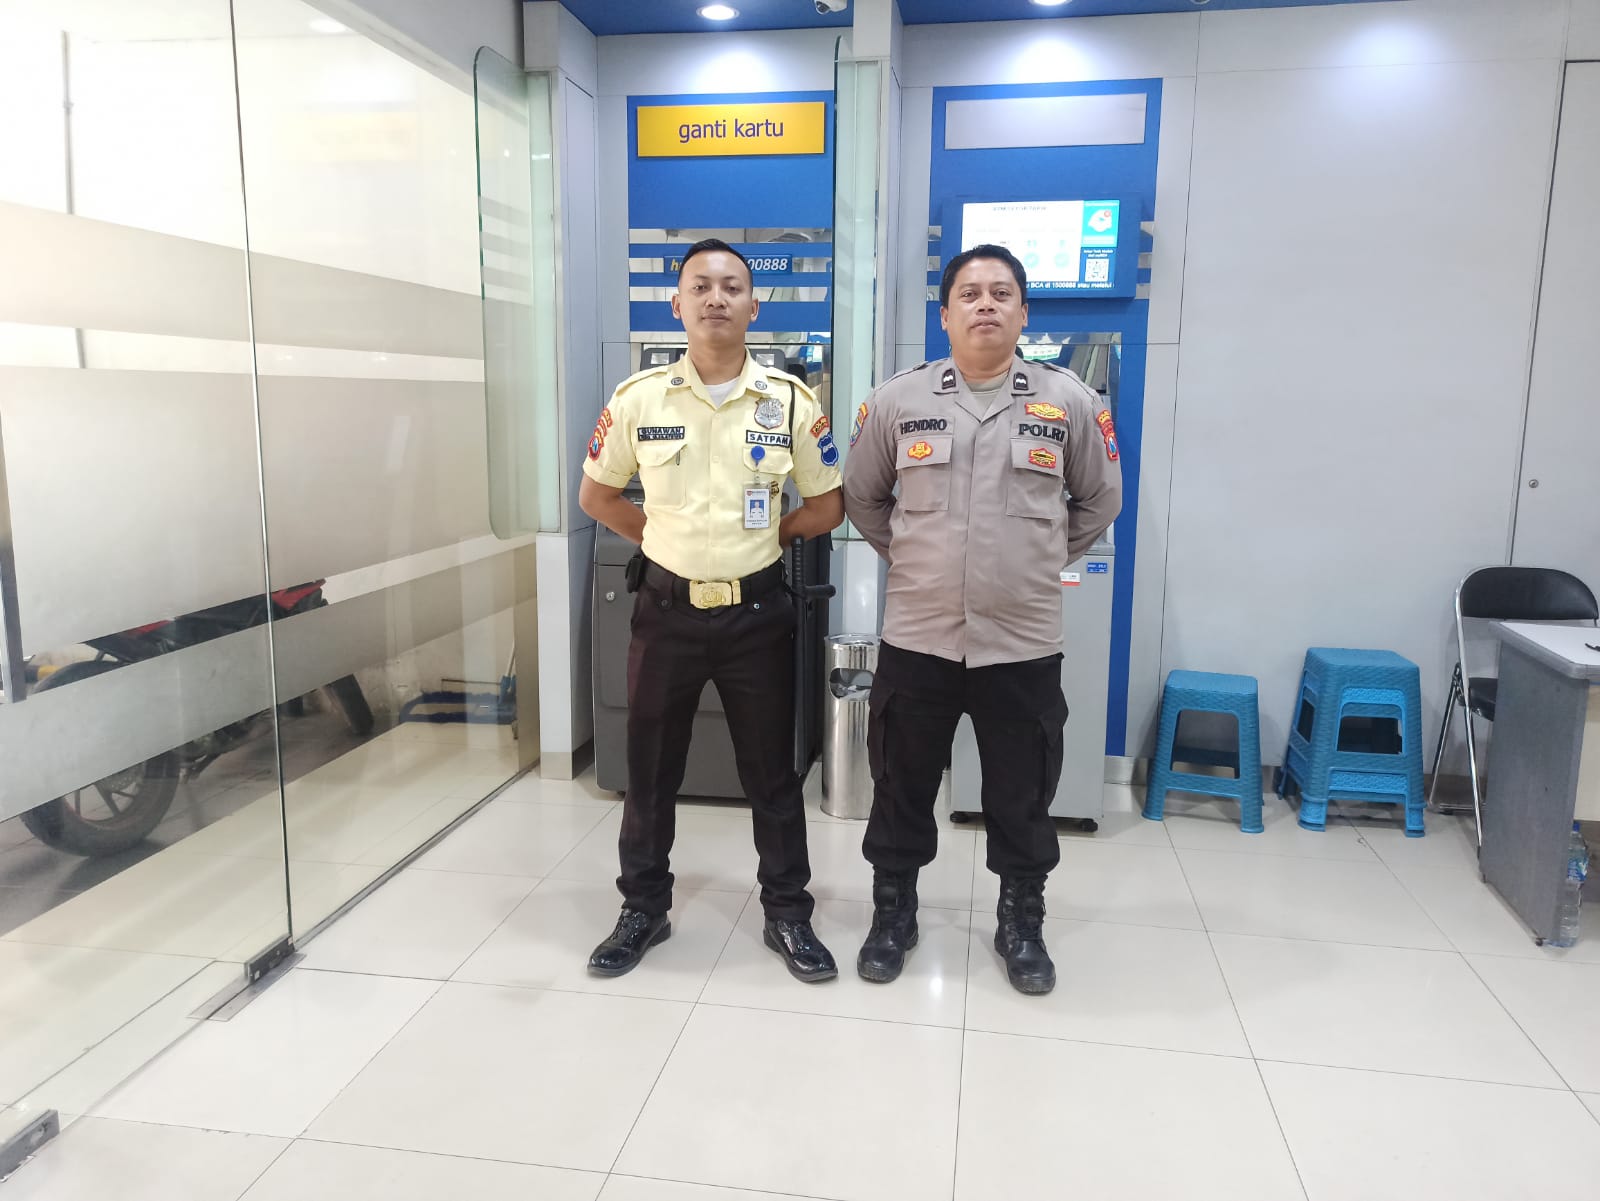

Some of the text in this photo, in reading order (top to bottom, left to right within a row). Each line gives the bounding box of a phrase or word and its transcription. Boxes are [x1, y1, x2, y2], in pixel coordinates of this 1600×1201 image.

[679, 118, 784, 143] ganti kartu
[900, 418, 948, 435] HENDRO
[1018, 423, 1066, 443] POLRI
[749, 433, 789, 446] SATPAM
